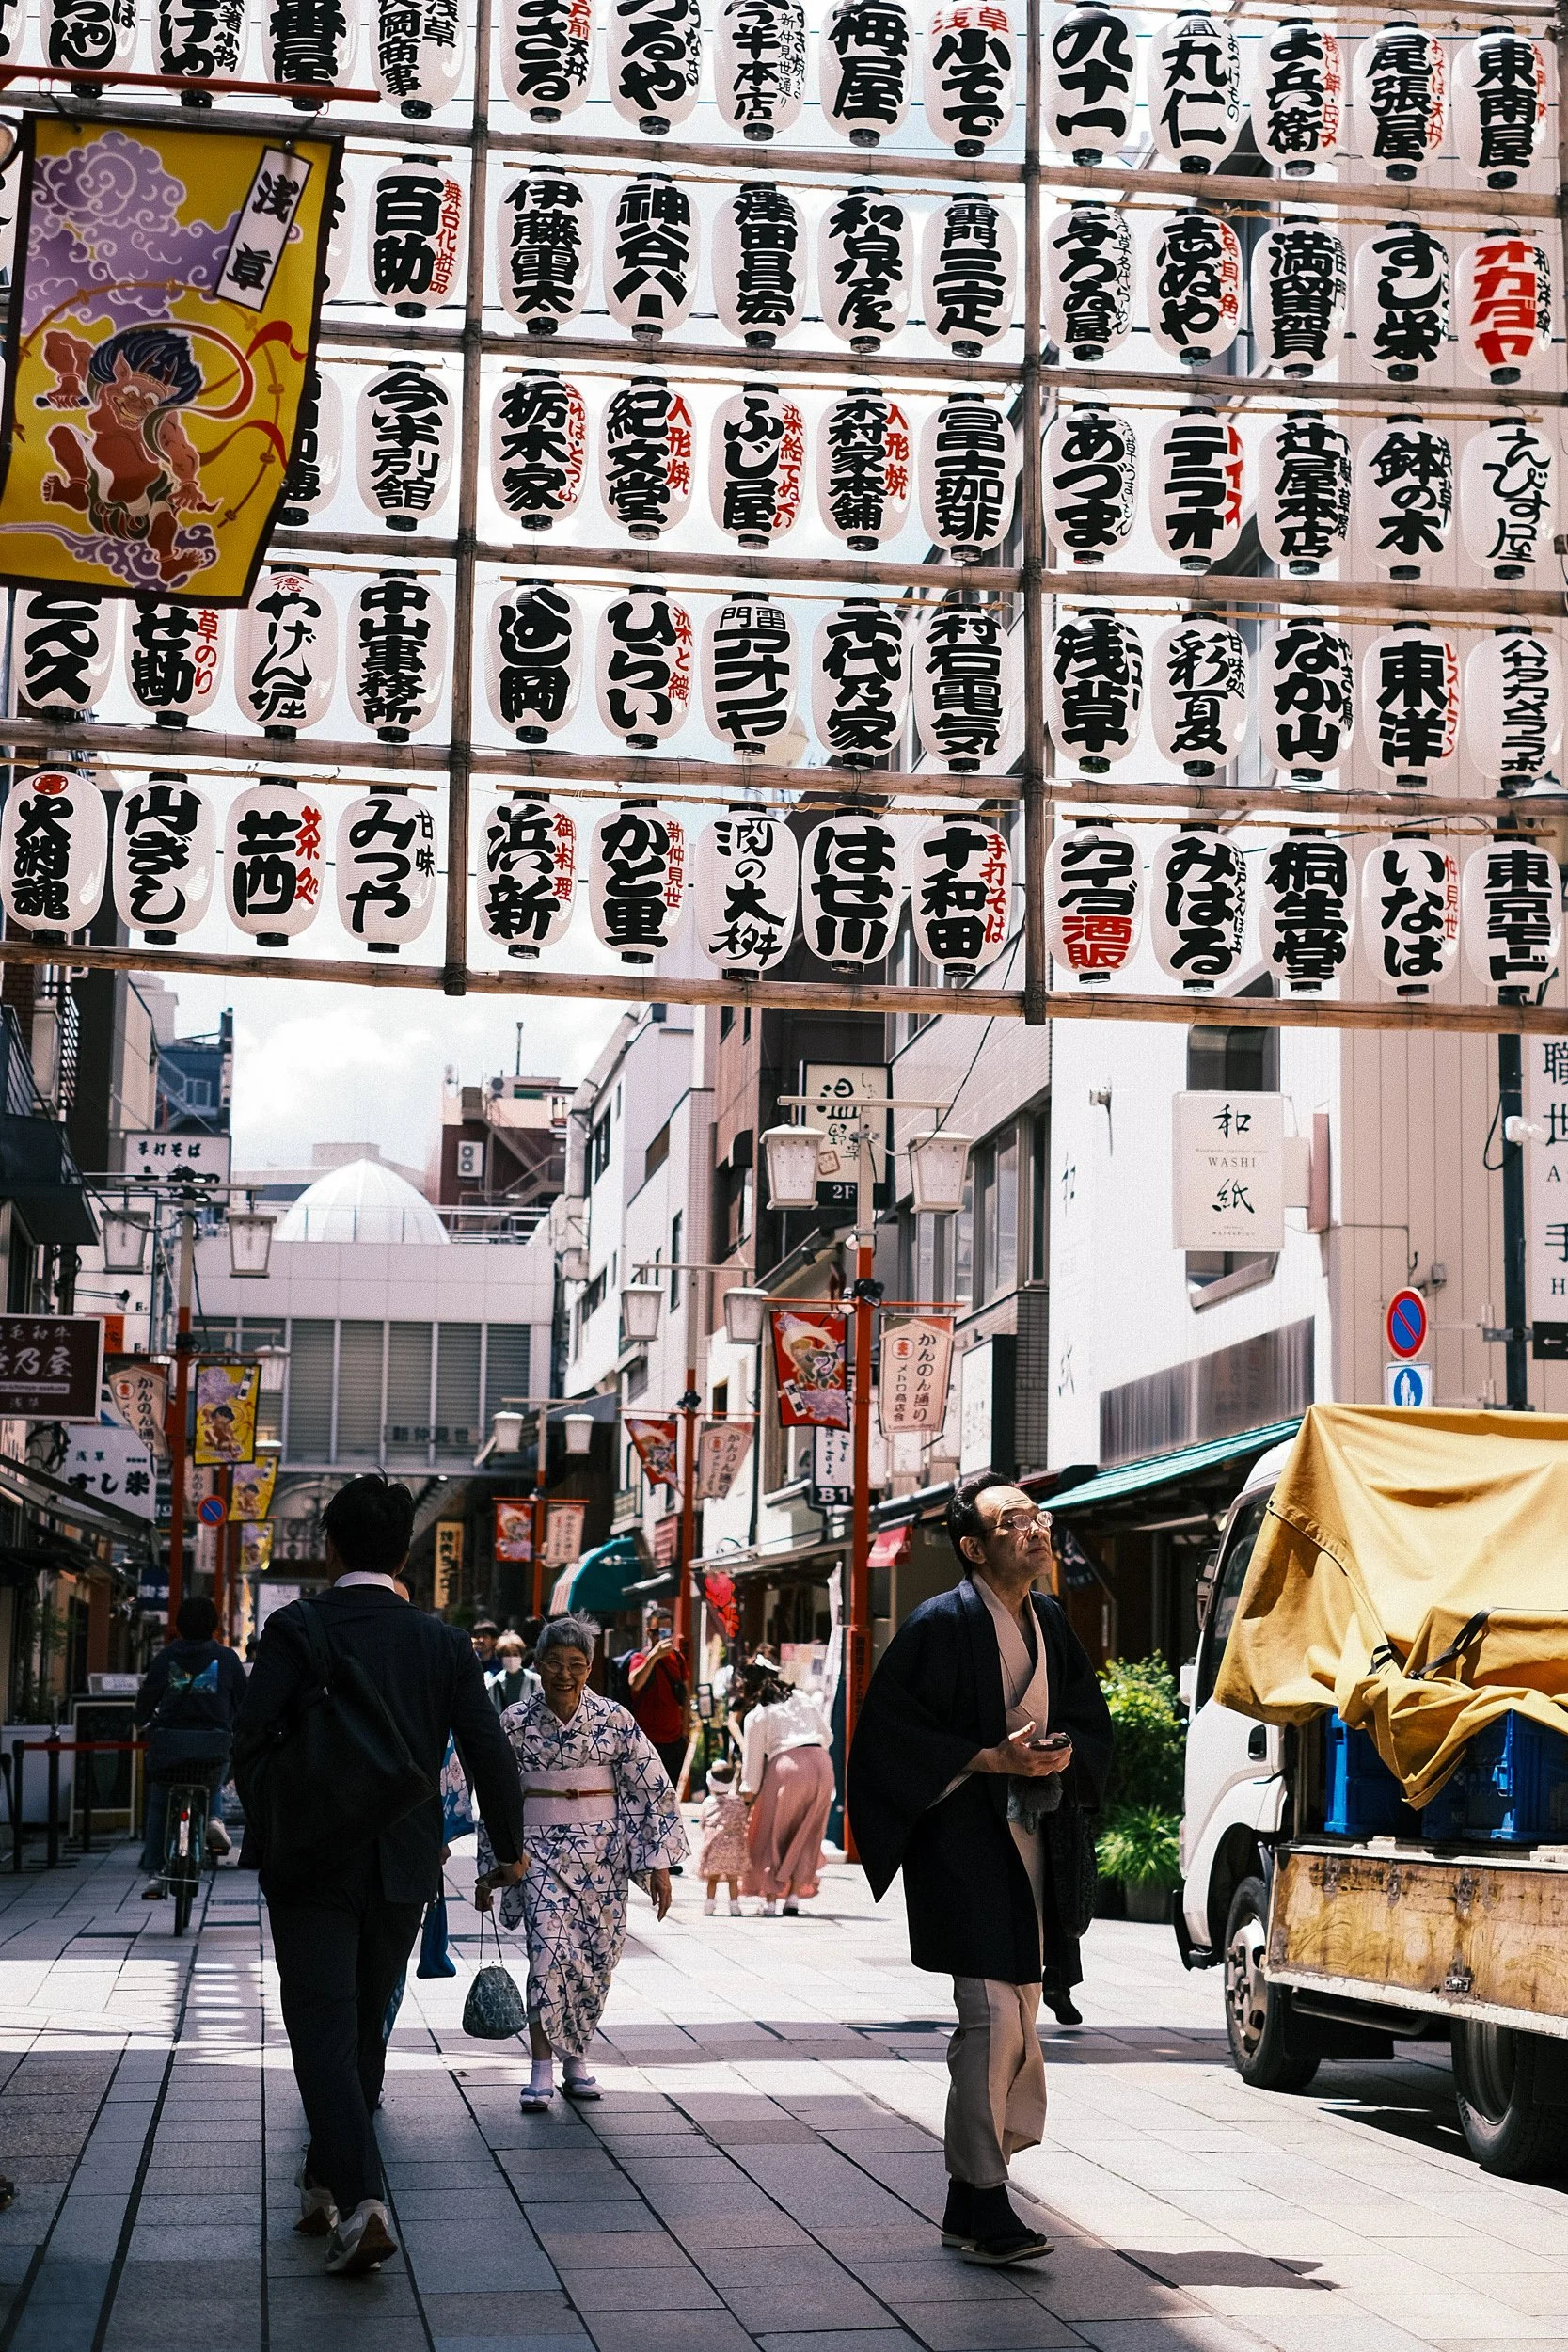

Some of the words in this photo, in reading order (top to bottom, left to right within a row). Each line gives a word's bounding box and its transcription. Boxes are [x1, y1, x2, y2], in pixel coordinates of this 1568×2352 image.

[723, 0, 789, 121] 今半本店
[932, 7, 1009, 34] 浅草
[932, 28, 1011, 137] 小そで
[1160, 40, 1228, 149] 丸仁
[1366, 34, 1433, 163] 尾張屋
[226, 171, 301, 293] 浅草
[372, 175, 447, 296] 百助
[429, 179, 463, 295] 舞台化粧品
[612, 183, 692, 320] 神谷バー
[828, 196, 905, 333] 和泉屋
[1372, 230, 1446, 363] すし栄
[1470, 241, 1537, 366] オカダヤ
[368, 371, 449, 511] 今半別館
[498, 380, 570, 512] 栃木家
[605, 389, 671, 524] 紀文堂
[665, 393, 692, 496] 人形焼
[723, 396, 784, 532] ふじ屋
[772, 403, 805, 530] 染絵てぬぐい
[828, 398, 889, 531] 木村家本舗
[884, 403, 910, 501] 人形焼
[934, 406, 1006, 541] 富士珈琲
[1053, 412, 1126, 548] あづま
[1275, 421, 1338, 559] 辻屋本店
[1369, 431, 1449, 556] 鉢の木
[248, 592, 323, 723] やげん堀
[357, 580, 432, 724] 中山事務所
[607, 601, 677, 730] ひらい
[823, 610, 904, 751] 千代乃家
[925, 614, 1003, 756] 村石電気
[1053, 619, 1131, 753] 浅草
[1169, 629, 1230, 754] 彩夏
[1225, 630, 1246, 700] 甘味処
[1274, 628, 1343, 763] なか山
[1376, 640, 1449, 768] 東洋
[346, 799, 417, 934] みつや
[415, 808, 436, 878] 甘味
[484, 803, 561, 941] 浜新
[552, 812, 577, 902] 御料理
[600, 813, 671, 948] かと里
[663, 820, 685, 910] 新仲見世
[811, 825, 896, 960] はせ川
[920, 827, 990, 960] 十和田
[979, 834, 1009, 944] 手打そば
[1165, 836, 1237, 976] みはる
[1264, 841, 1349, 980] 桐生堂
[1380, 850, 1447, 978] いなば
[137, 1140, 202, 1159] 手打そば
[1208, 1156, 1256, 1168] WASHI
[1213, 1104, 1252, 1139] 和
[832, 1184, 856, 1200] 2F
[1212, 1178, 1256, 1214] 紙
[0, 1324, 71, 1343] 毛和牛
[913, 1333, 937, 1422] かんのん通り
[68, 1470, 150, 1496] すし栄
[818, 1487, 848, 1502] B1
